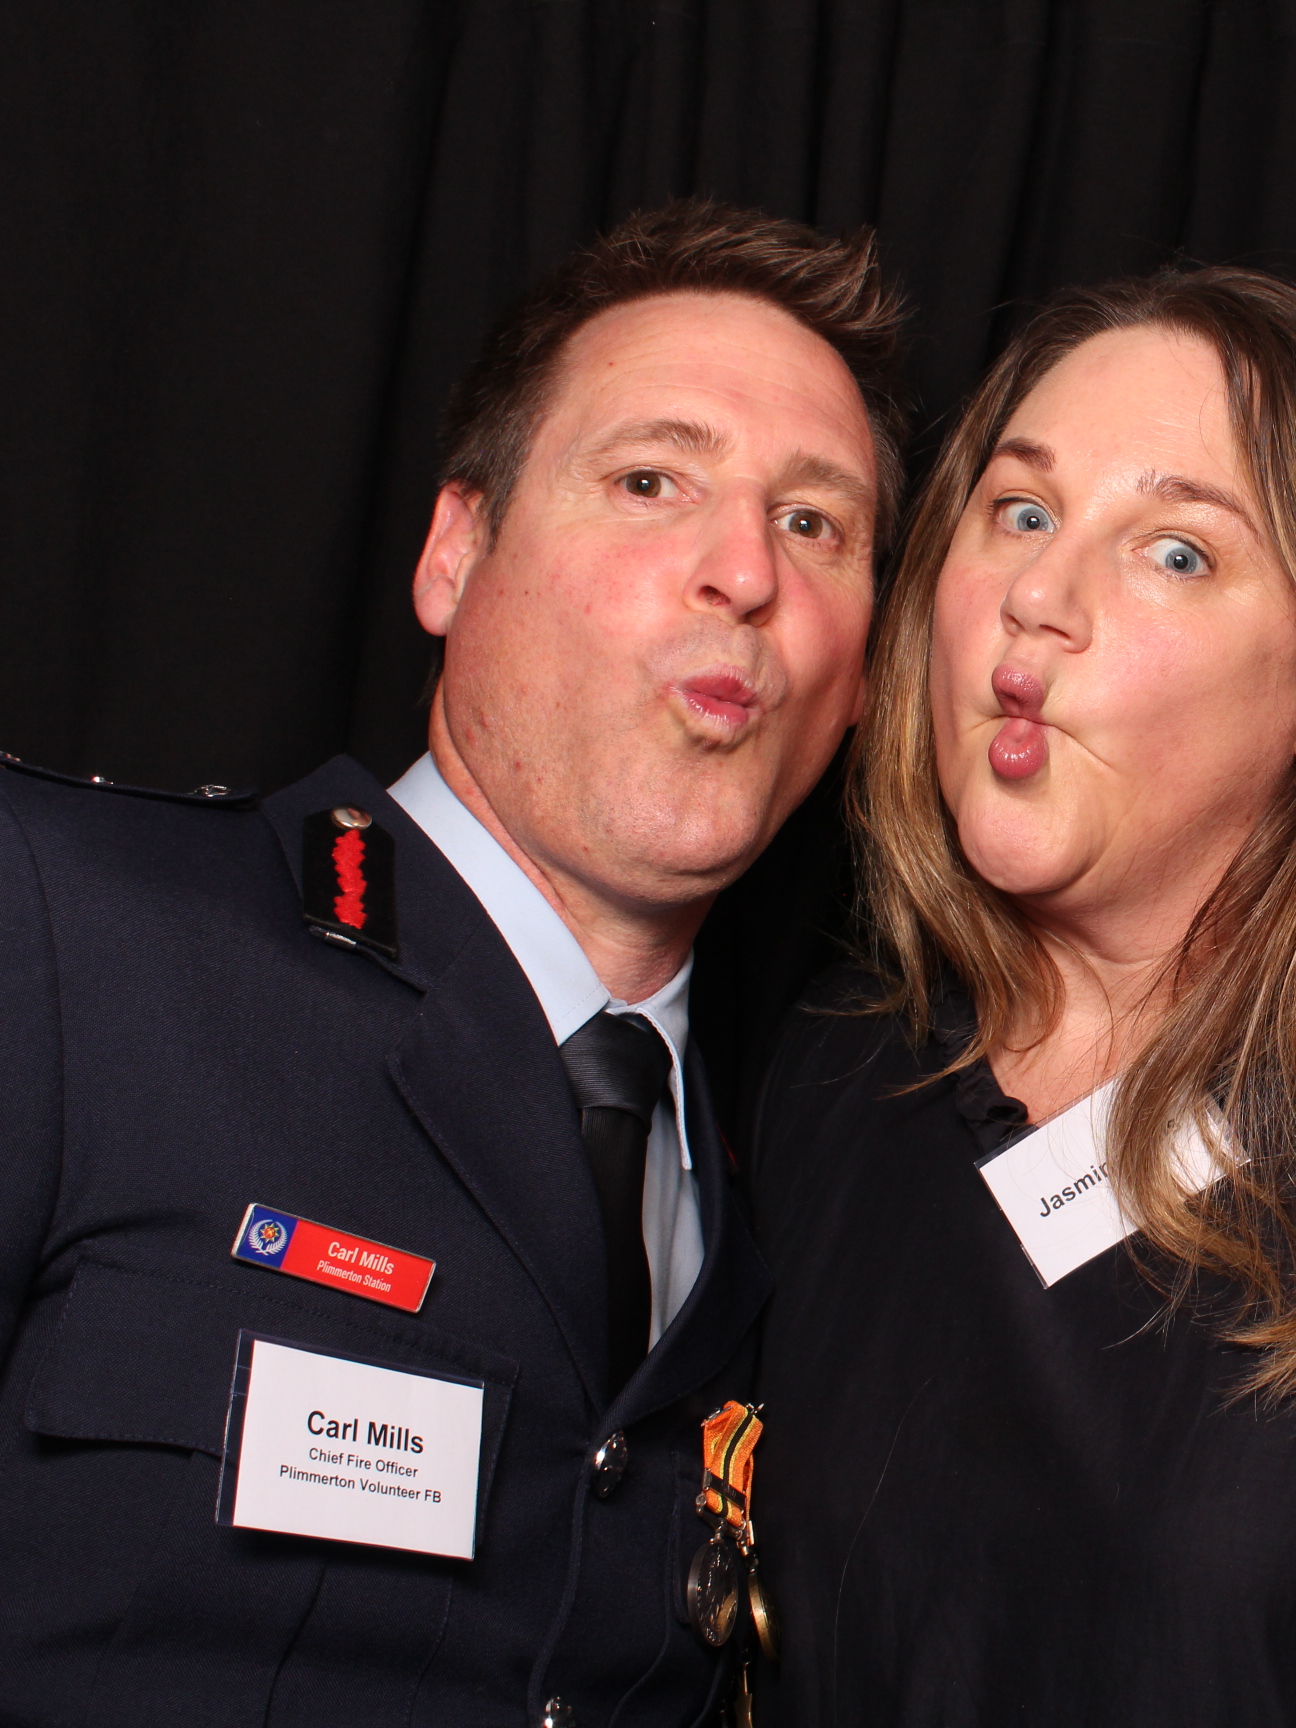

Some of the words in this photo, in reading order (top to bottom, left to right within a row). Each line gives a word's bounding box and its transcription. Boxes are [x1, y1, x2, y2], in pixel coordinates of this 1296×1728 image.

[327, 1241, 360, 1263] Carl
[359, 1251, 395, 1275] Mills
[316, 1260, 362, 1284] Plimmerton
[363, 1274, 391, 1292] Station
[307, 1410, 358, 1442] Carl
[367, 1421, 424, 1454] Mills
[309, 1447, 344, 1465] Chief
[347, 1454, 371, 1470] Fire
[375, 1459, 418, 1478] Officer
[279, 1464, 355, 1490] Plimmerton
[360, 1478, 421, 1500] Volunteer
[424, 1489, 442, 1503] FB
